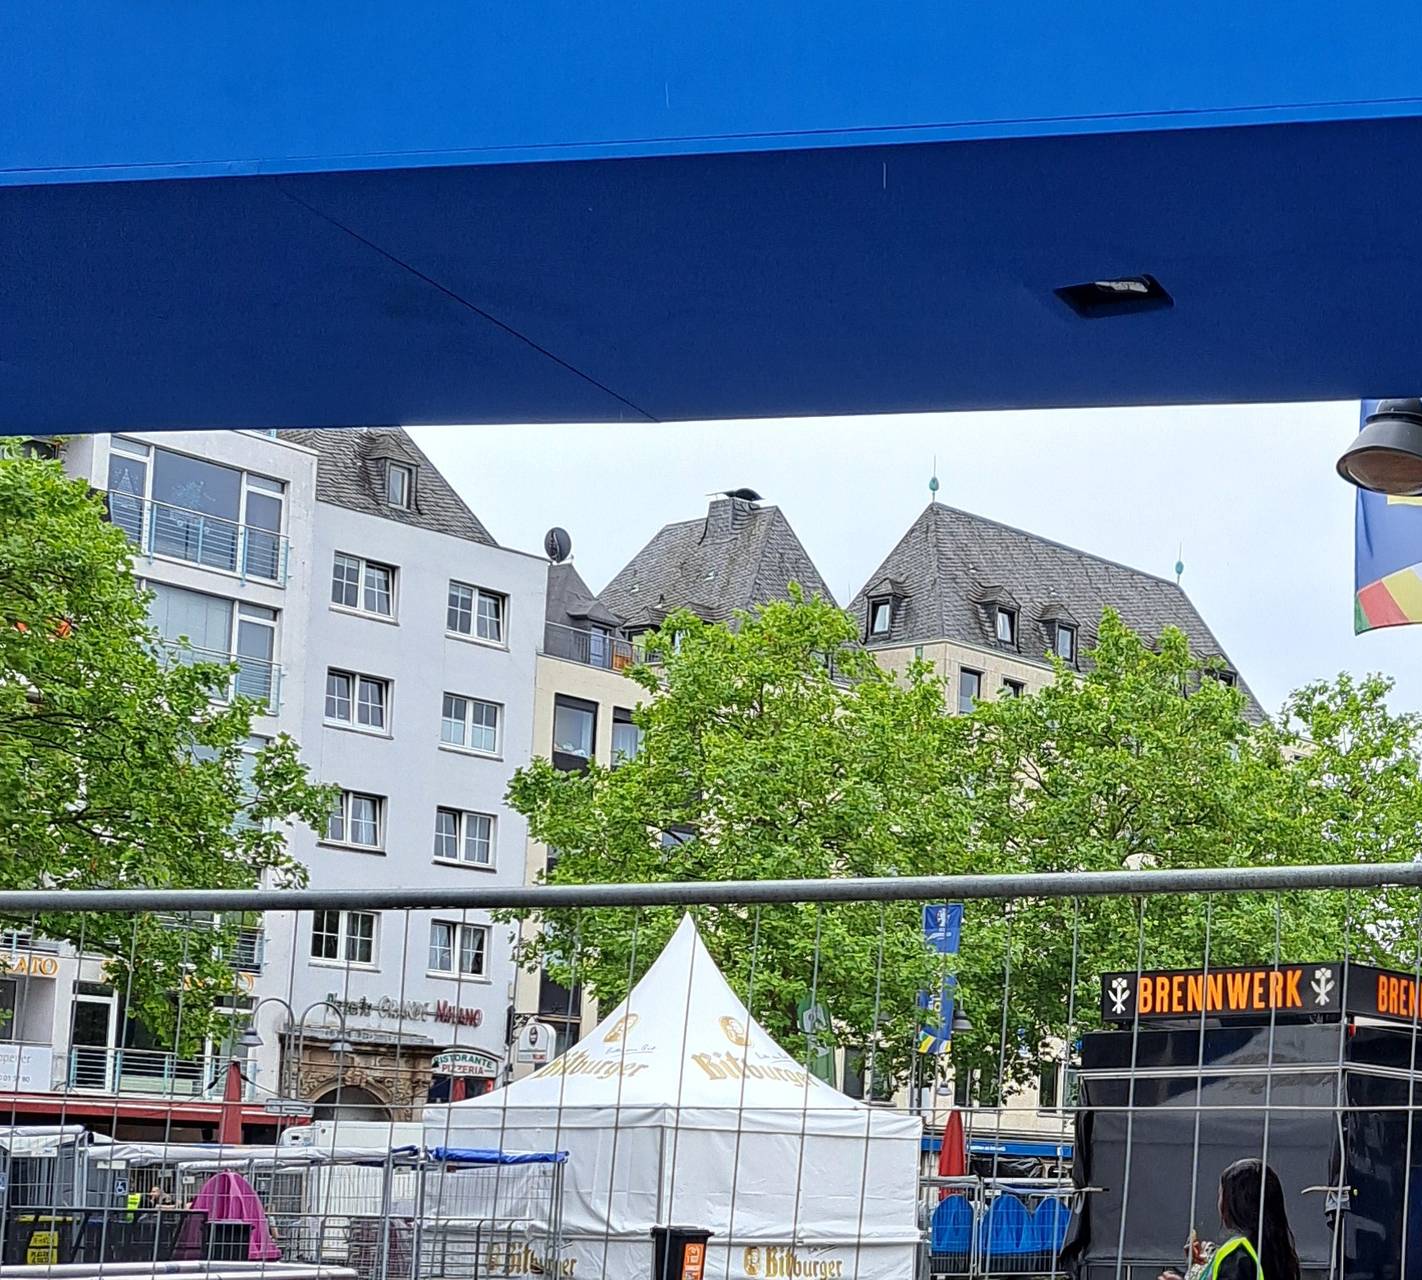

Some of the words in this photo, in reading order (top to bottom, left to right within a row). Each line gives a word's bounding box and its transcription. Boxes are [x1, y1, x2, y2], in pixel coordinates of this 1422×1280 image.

[1138, 969, 1303, 1015] BRENNWERK
[441, 1063, 485, 1076] PIZZERIA
[764, 1246, 843, 1279] Bitburger
